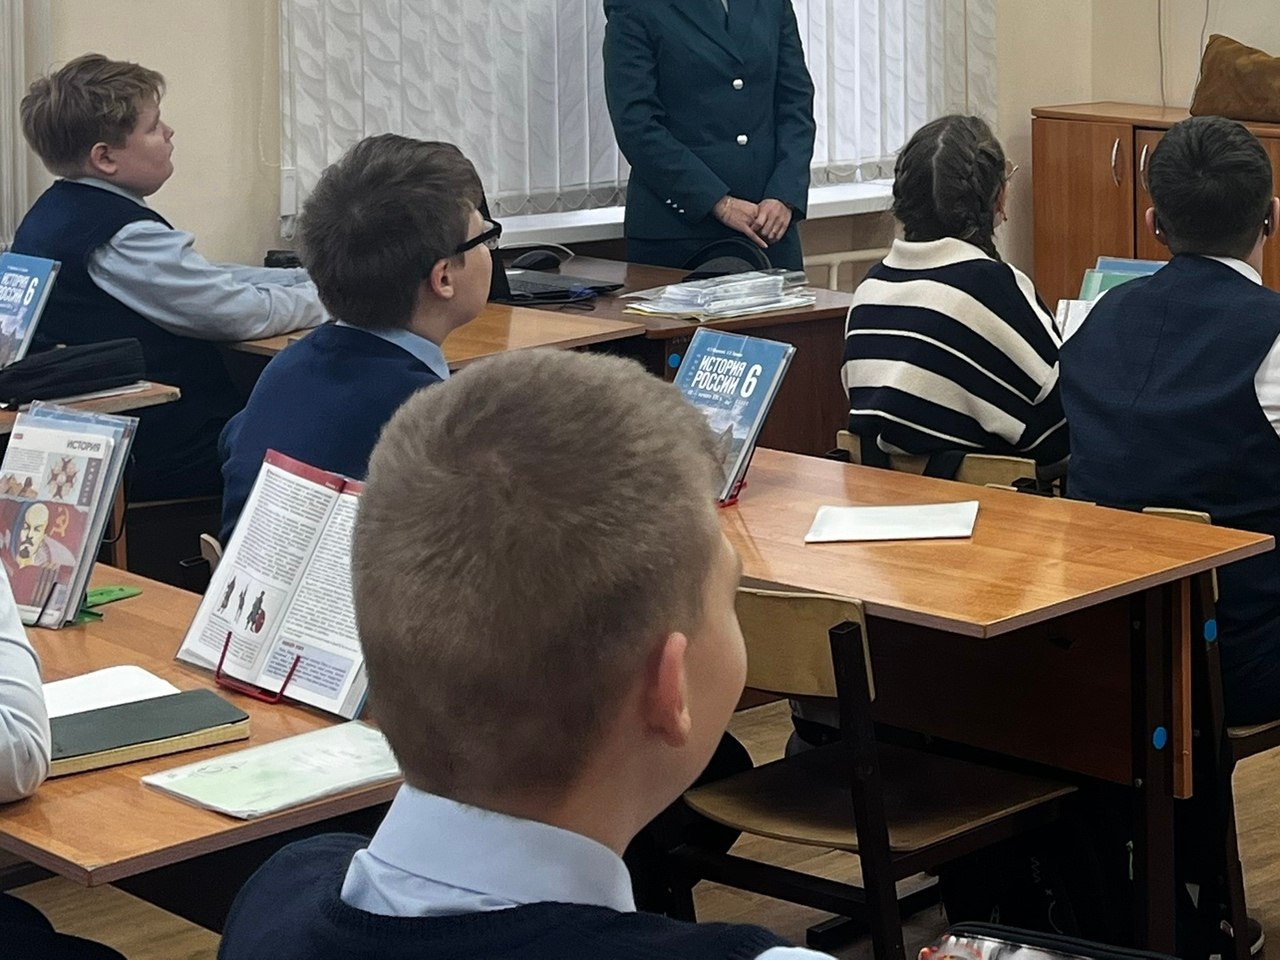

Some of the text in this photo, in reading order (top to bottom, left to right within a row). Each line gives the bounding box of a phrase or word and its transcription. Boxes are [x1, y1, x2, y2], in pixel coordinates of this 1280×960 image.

[23, 277, 39, 306] 6
[699, 354, 747, 377] ИСТОРИЯ
[691, 370, 740, 395] РОССИИ
[740, 363, 762, 398] 6
[67, 440, 101, 452] ИСТОРИЯ
